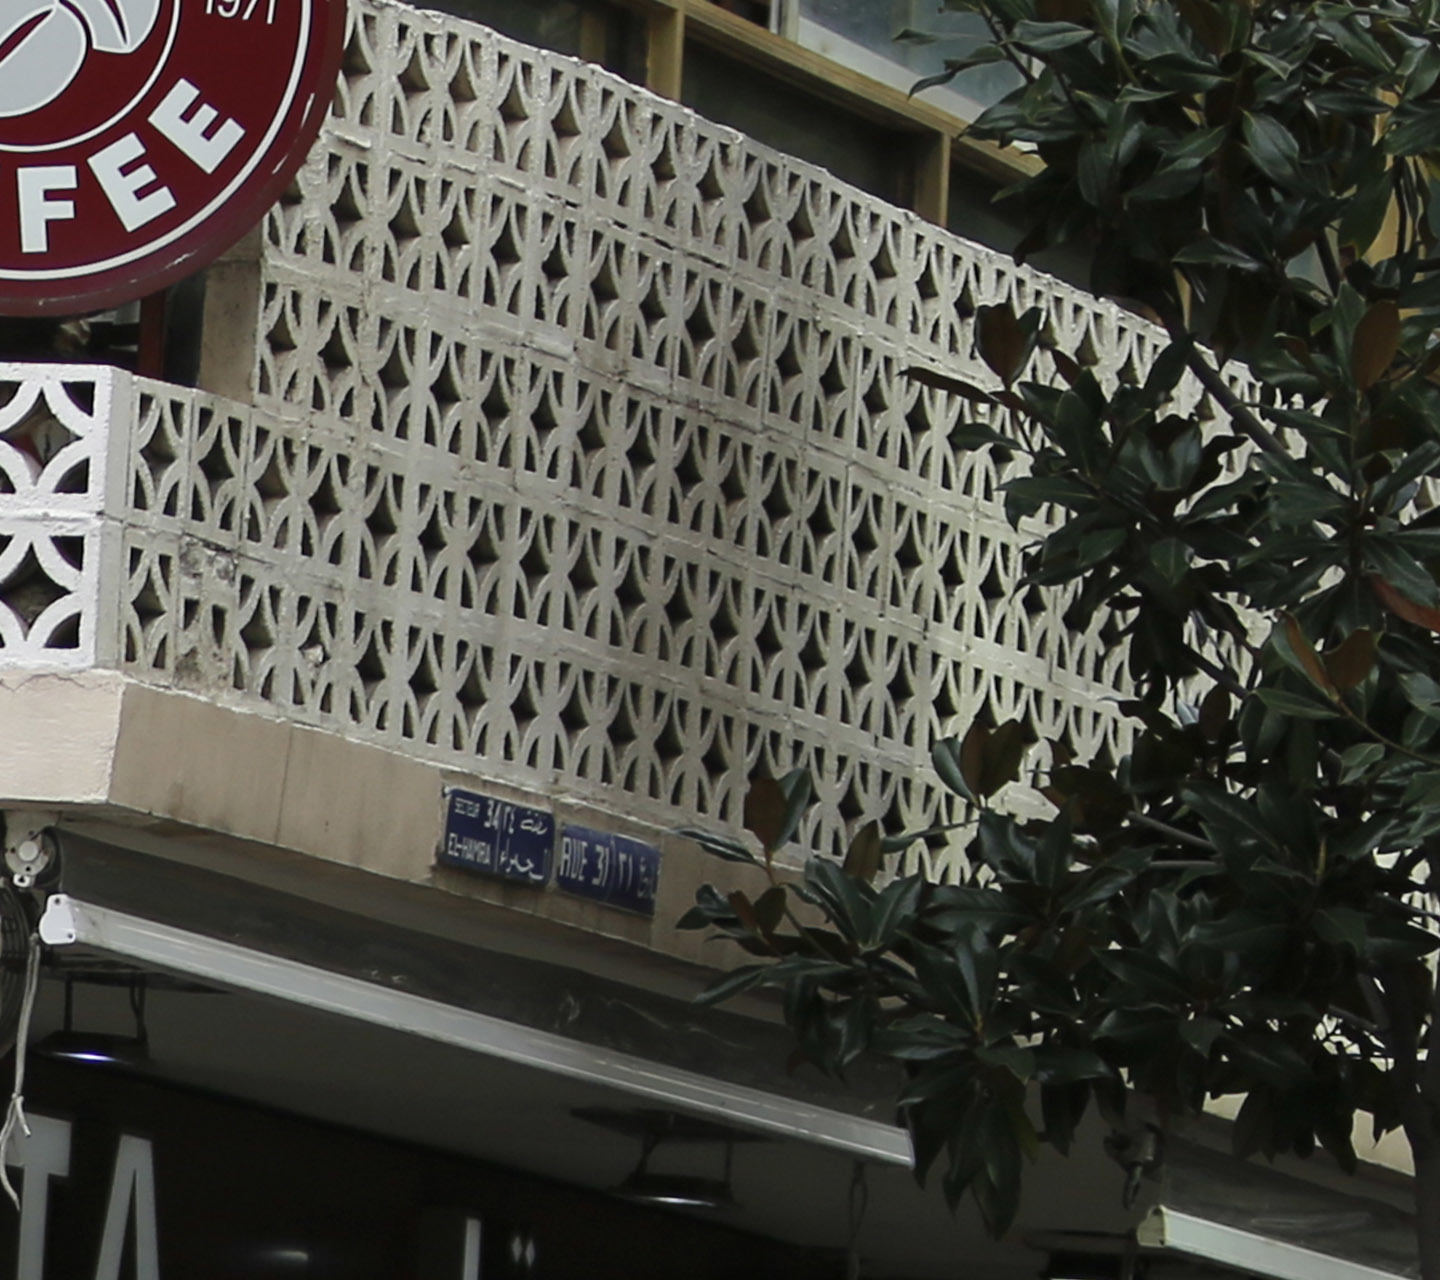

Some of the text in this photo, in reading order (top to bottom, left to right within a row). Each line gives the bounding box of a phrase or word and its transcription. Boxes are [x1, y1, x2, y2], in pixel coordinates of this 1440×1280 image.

[483, 799, 501, 830] 34
[559, 836, 610, 888] RUE 31
